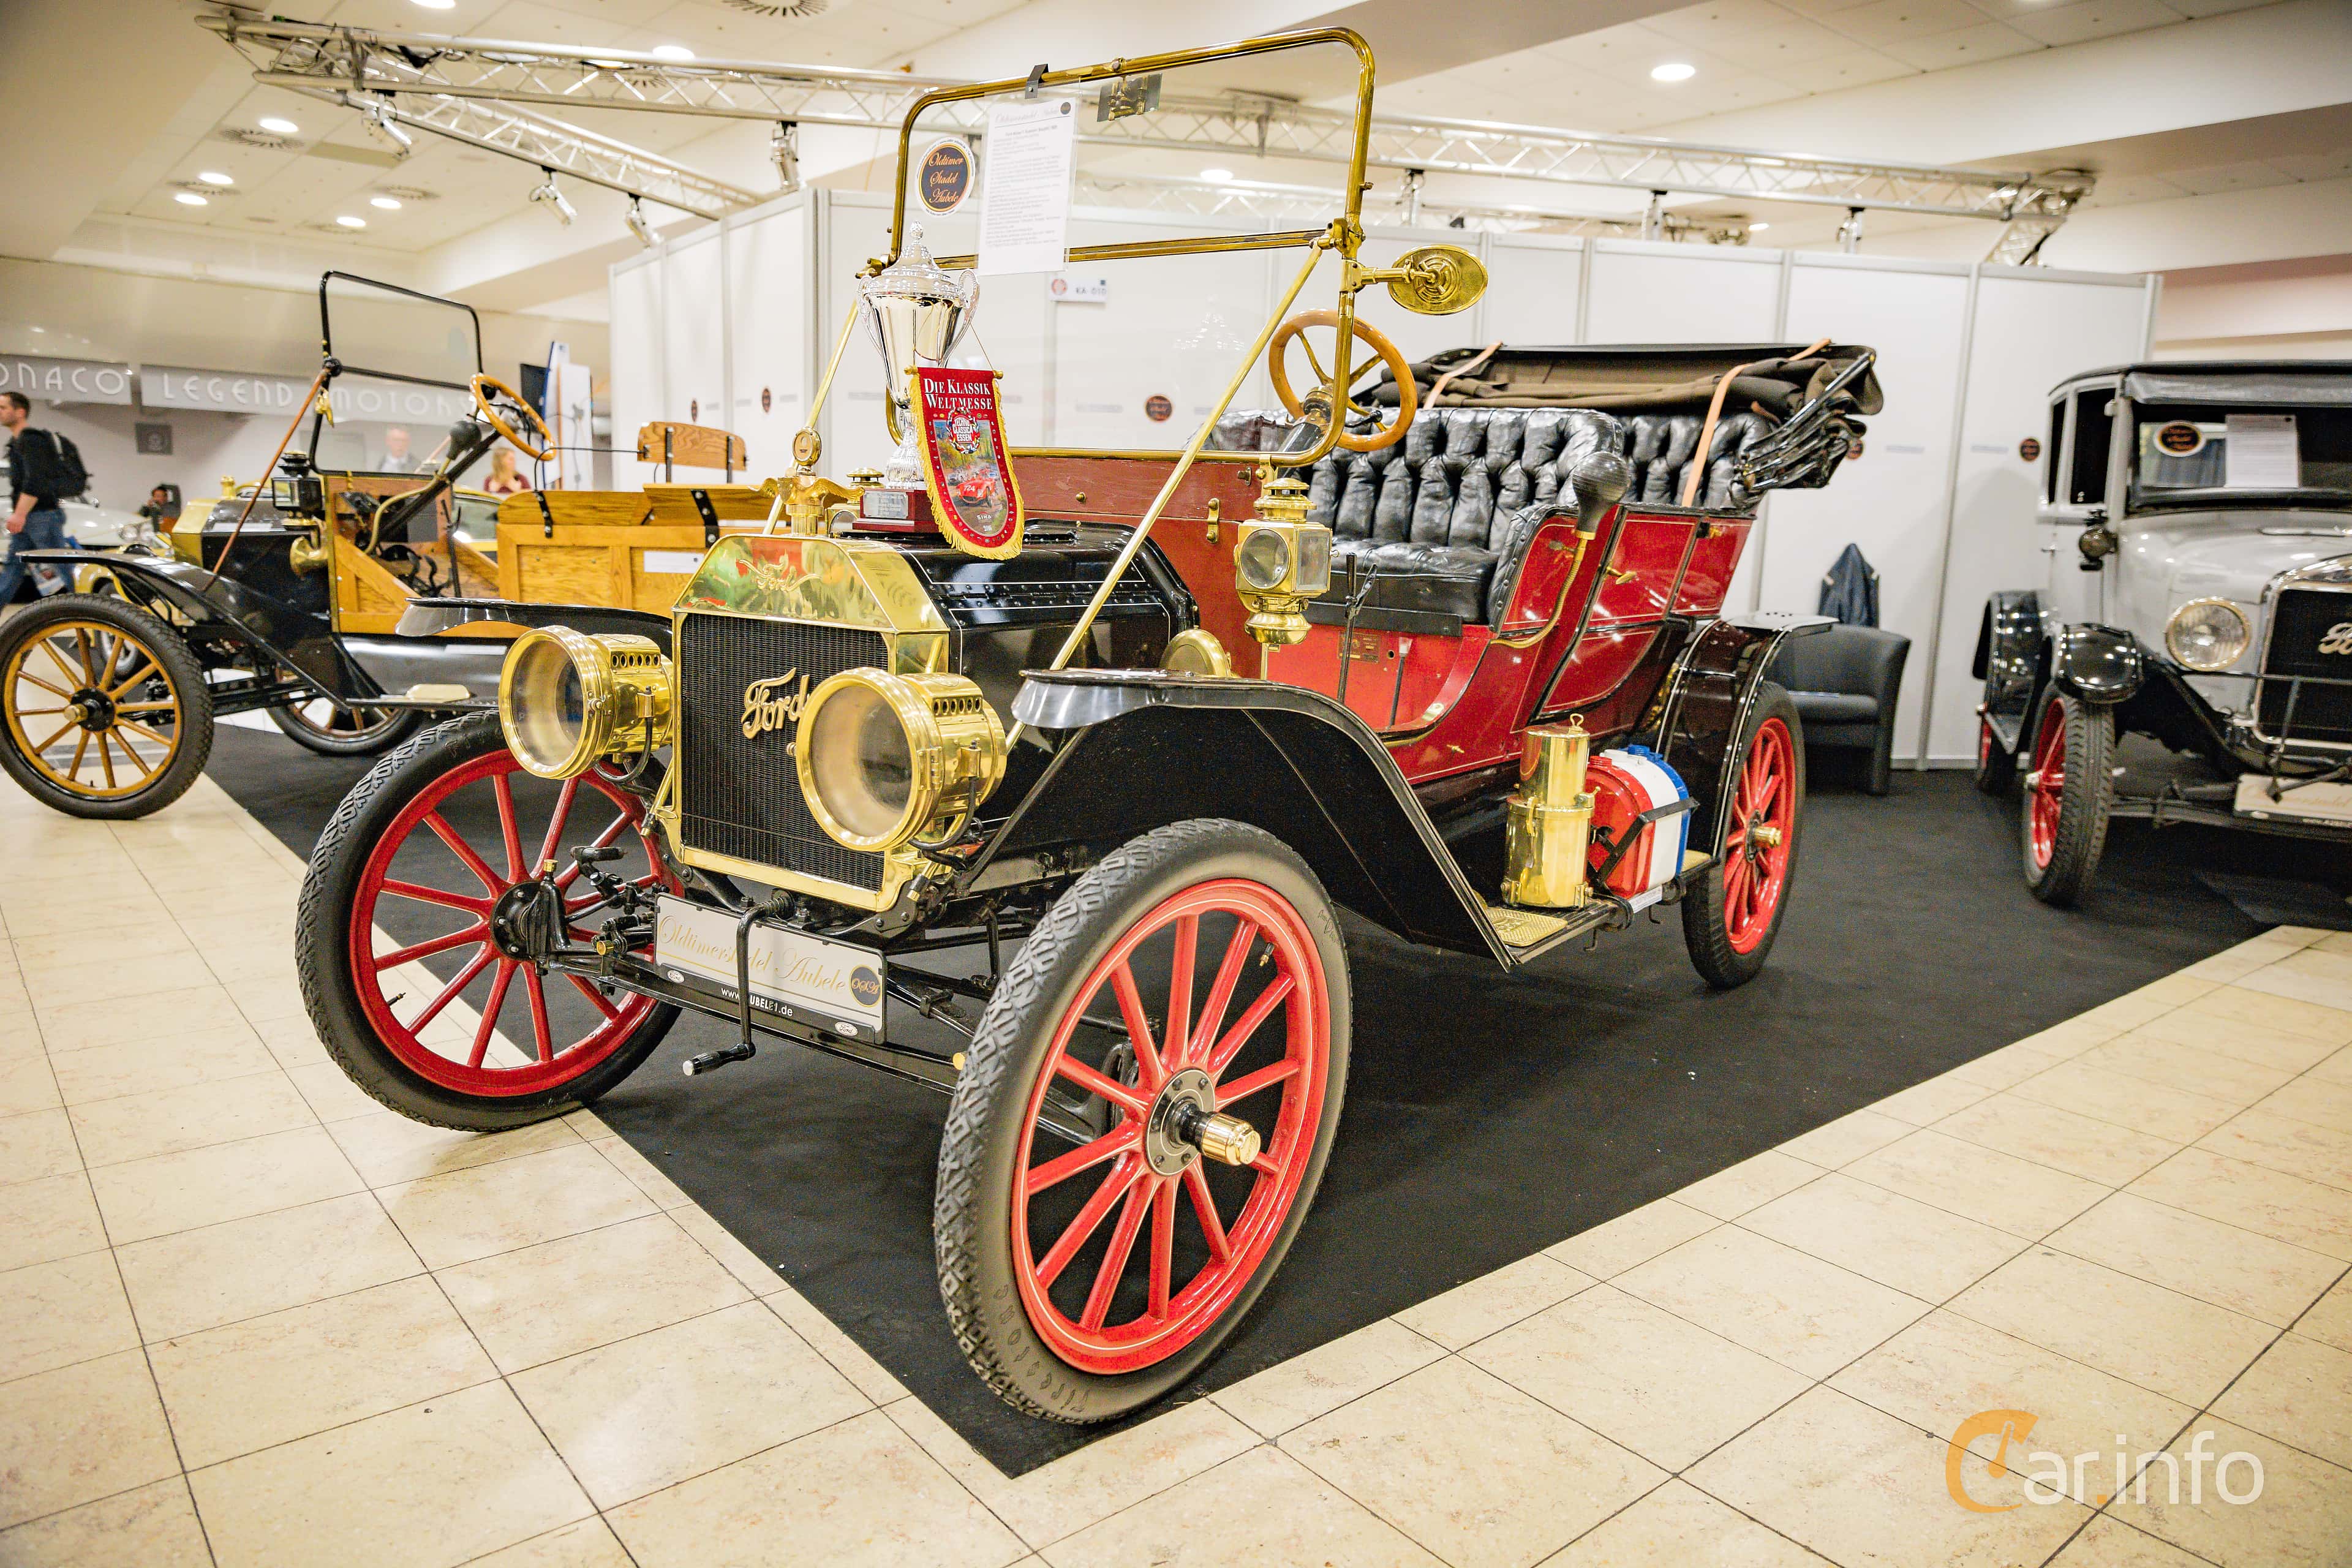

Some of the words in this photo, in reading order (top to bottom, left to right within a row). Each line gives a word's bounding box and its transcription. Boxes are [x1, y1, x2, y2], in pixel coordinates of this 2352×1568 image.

[929, 152, 963, 167] Oldtimer
[930, 170, 959, 187] Stadel
[929, 188, 959, 203] Aubele
[163, 372, 293, 408] LEGEND
[924, 378, 945, 393] DIE
[947, 379, 990, 395] KLASSIK
[952, 423, 973, 434] CLASSICA
[954, 417, 970, 427] TECHNO
[741, 667, 810, 740] Ford
[774, 947, 846, 995] Aubele
[838, 1024, 854, 1035] Ford
